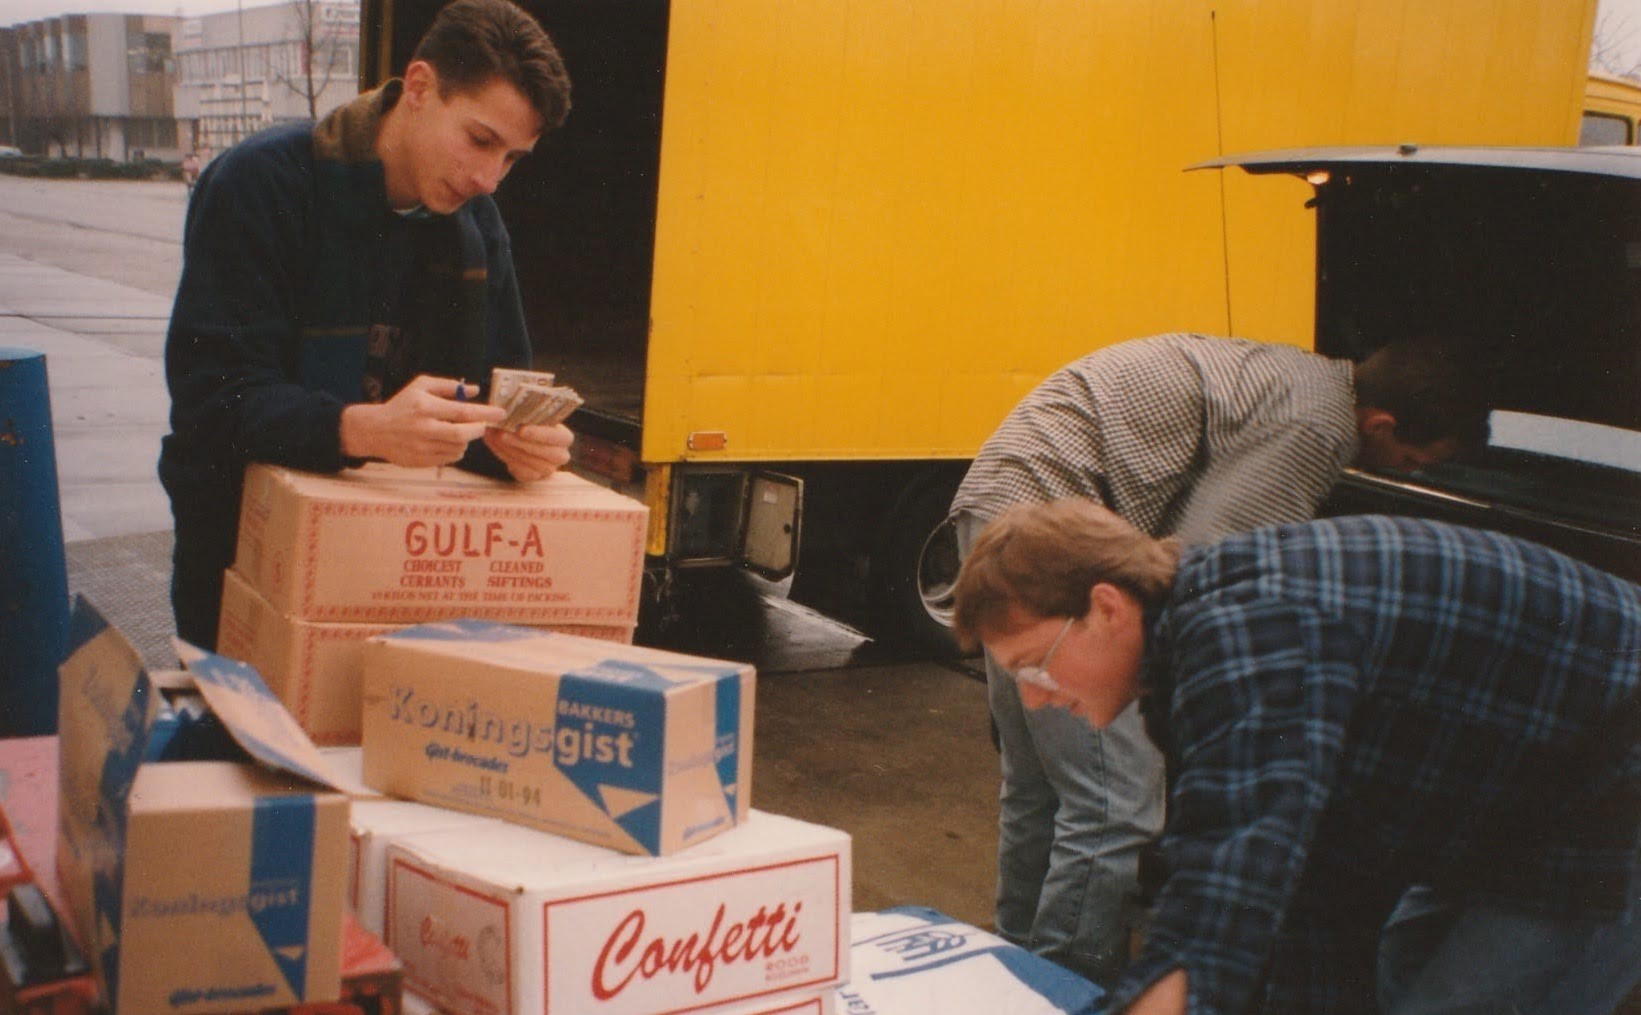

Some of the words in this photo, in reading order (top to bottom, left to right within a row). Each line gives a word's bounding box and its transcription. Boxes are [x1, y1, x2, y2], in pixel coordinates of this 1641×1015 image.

[405, 521, 544, 557] GULF-A
[403, 559, 463, 573] CHOICEST
[488, 561, 544, 574] CLEANED
[400, 575, 466, 588] CURRANTS
[487, 576, 552, 588] SIFTINGS
[558, 700, 636, 728] BAKKERS
[592, 901, 802, 1001] Confetti
